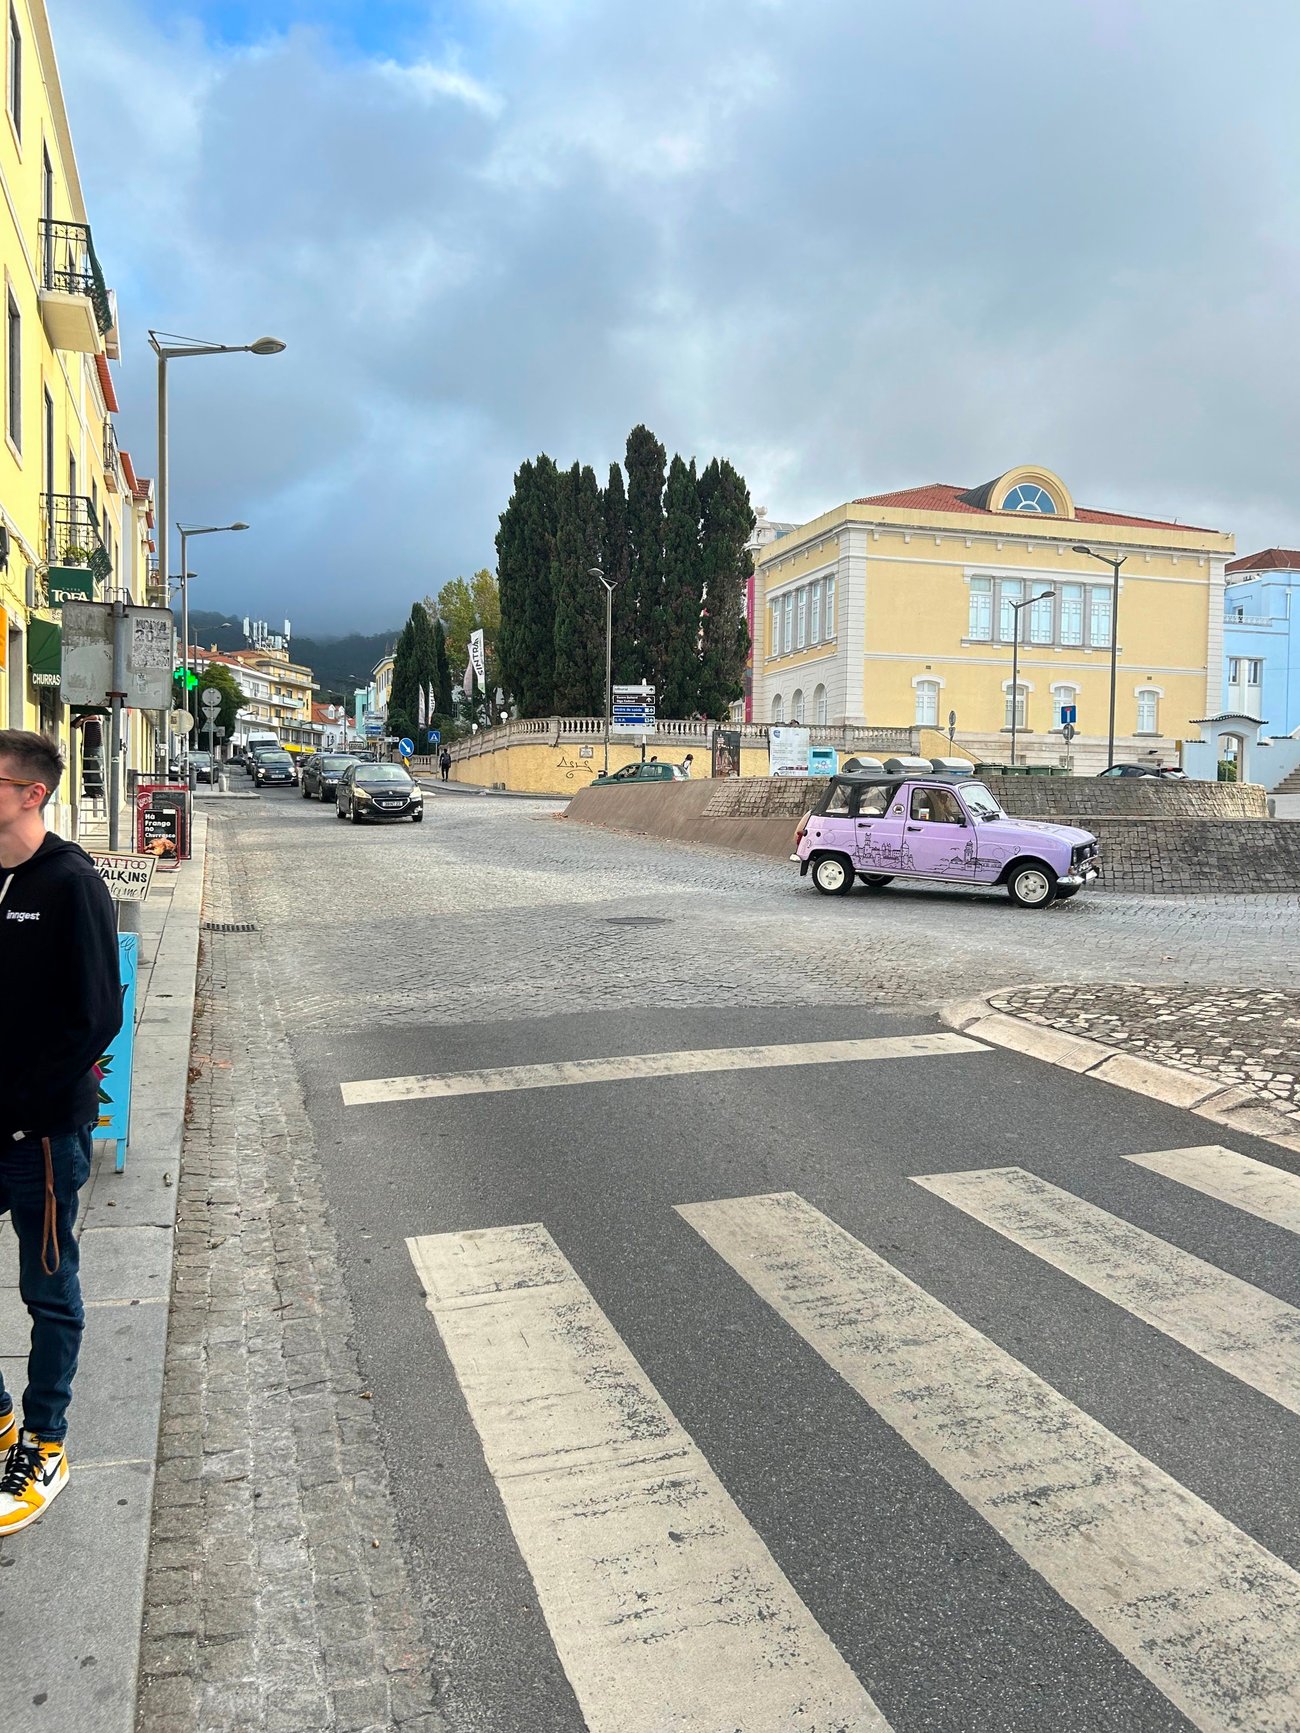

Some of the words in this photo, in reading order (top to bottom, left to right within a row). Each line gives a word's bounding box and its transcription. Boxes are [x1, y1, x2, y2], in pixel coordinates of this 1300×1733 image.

[51, 589, 91, 602] TOFA
[32, 673, 62, 686] CHURRAS
[144, 820, 171, 828] Frango
[93, 856, 147, 870] TATTOO
[6, 909, 41, 922] inngest
